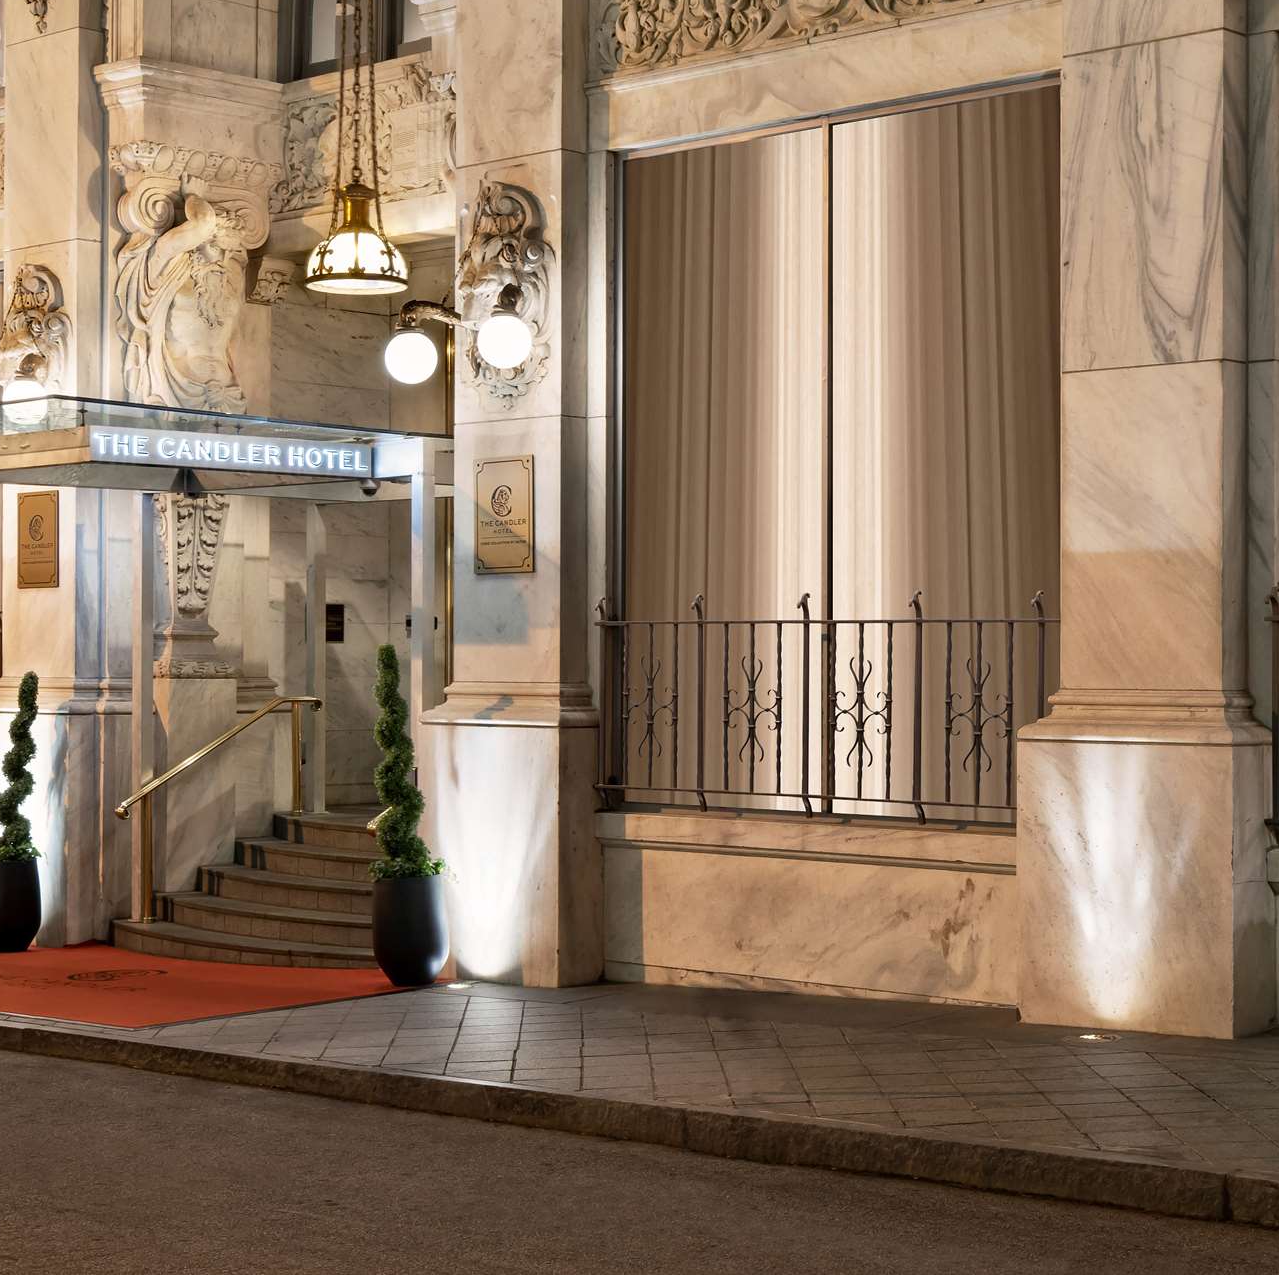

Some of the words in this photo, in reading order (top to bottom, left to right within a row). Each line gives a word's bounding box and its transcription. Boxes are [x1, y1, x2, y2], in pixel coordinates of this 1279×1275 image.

[93, 432, 150, 458] THE
[156, 437, 281, 466] CANDLER
[288, 445, 369, 472] HOTEL
[494, 518, 527, 527] CANDLER
